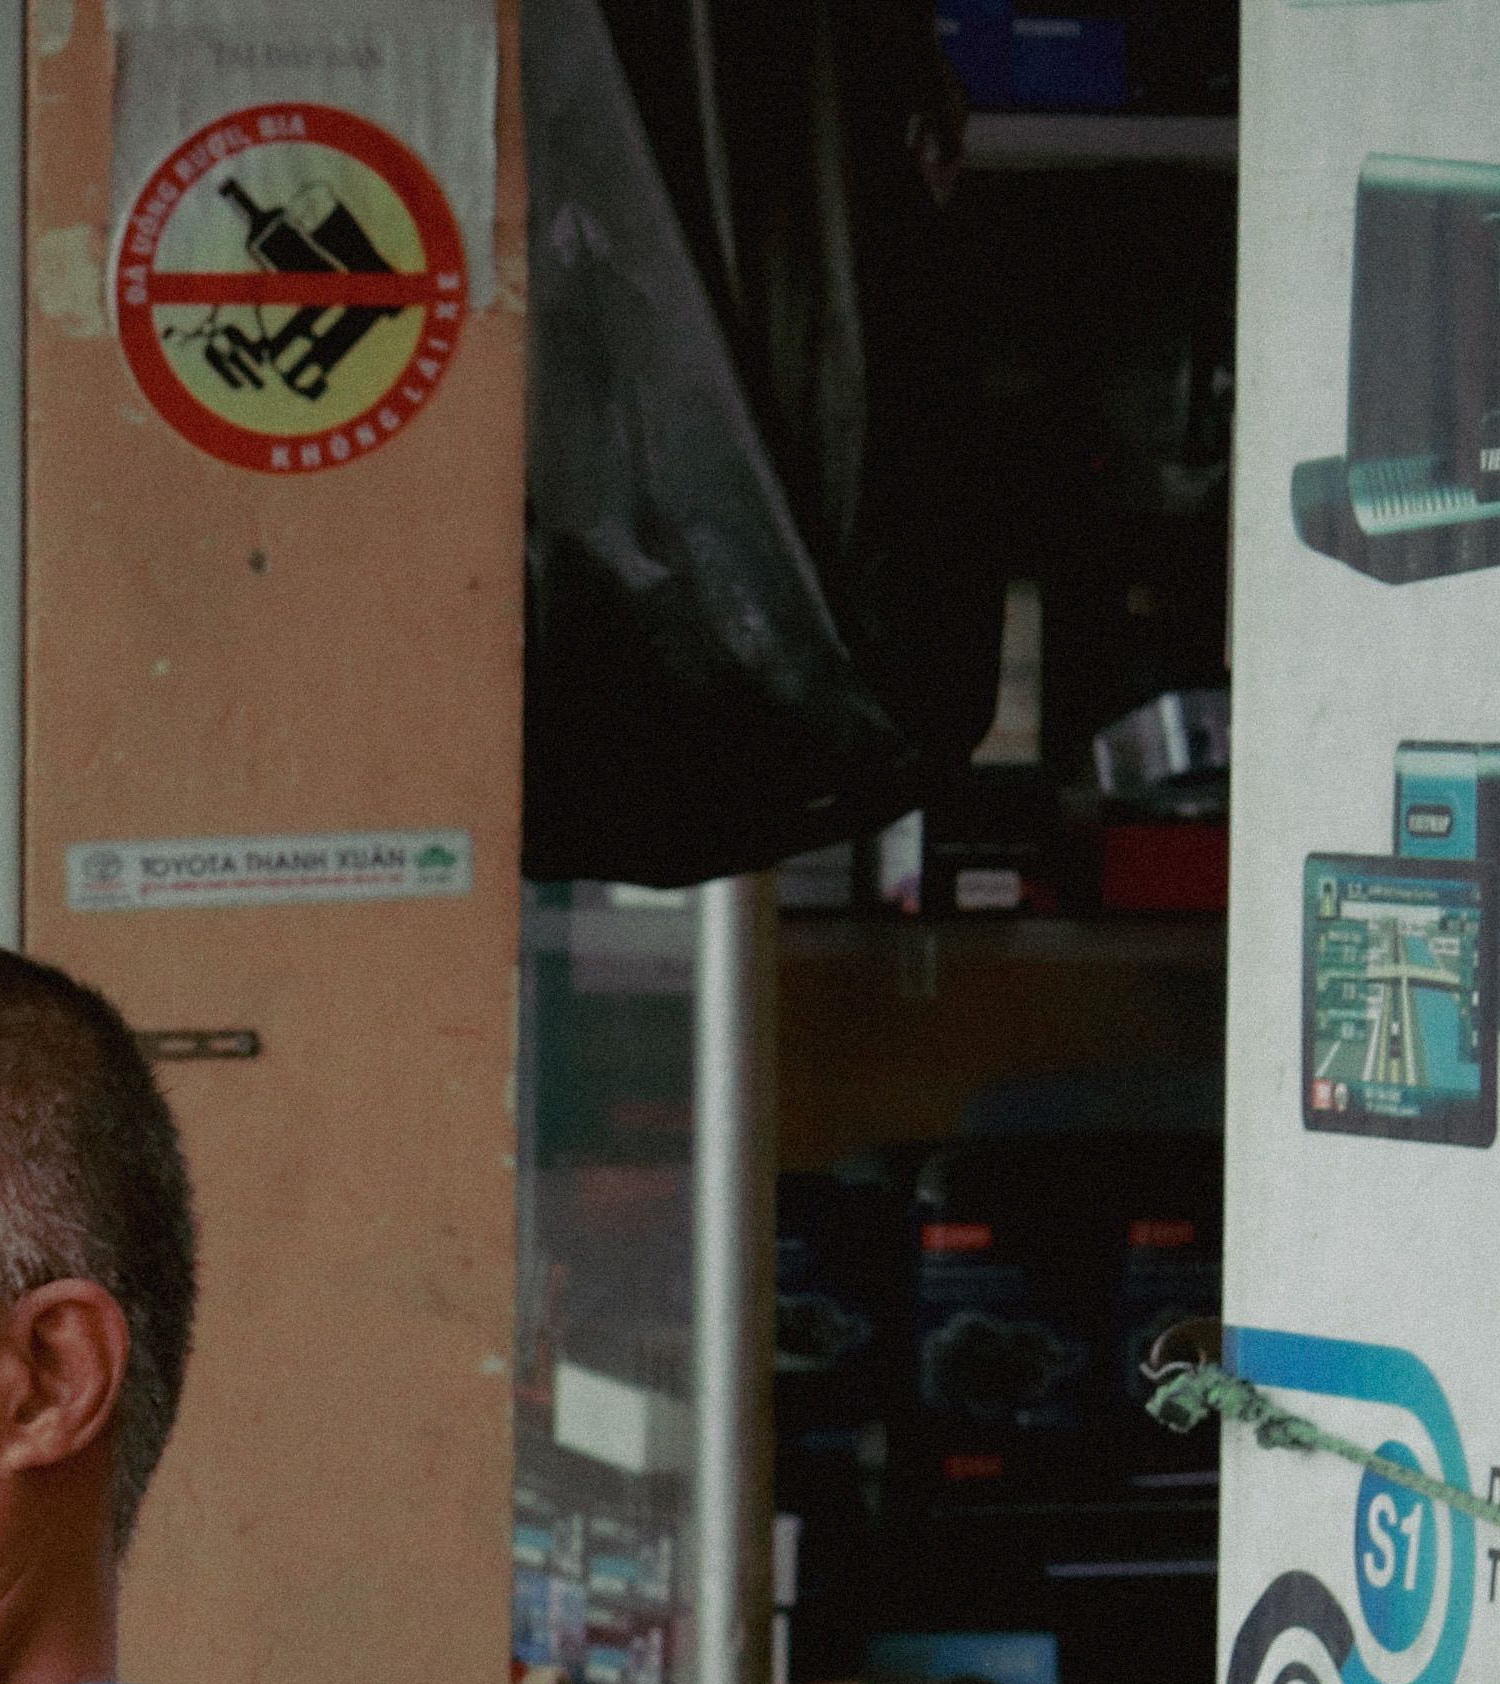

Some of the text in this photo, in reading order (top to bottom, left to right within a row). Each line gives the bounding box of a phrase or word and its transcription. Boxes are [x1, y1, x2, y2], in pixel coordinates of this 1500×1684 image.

[257, 114, 308, 141] BIA
[270, 407, 403, 471] KHÔNG
[436, 270, 462, 320] XE
[139, 851, 237, 878] TOYOTA
[245, 850, 329, 874] THANH
[1362, 1494, 1423, 1592] S1
